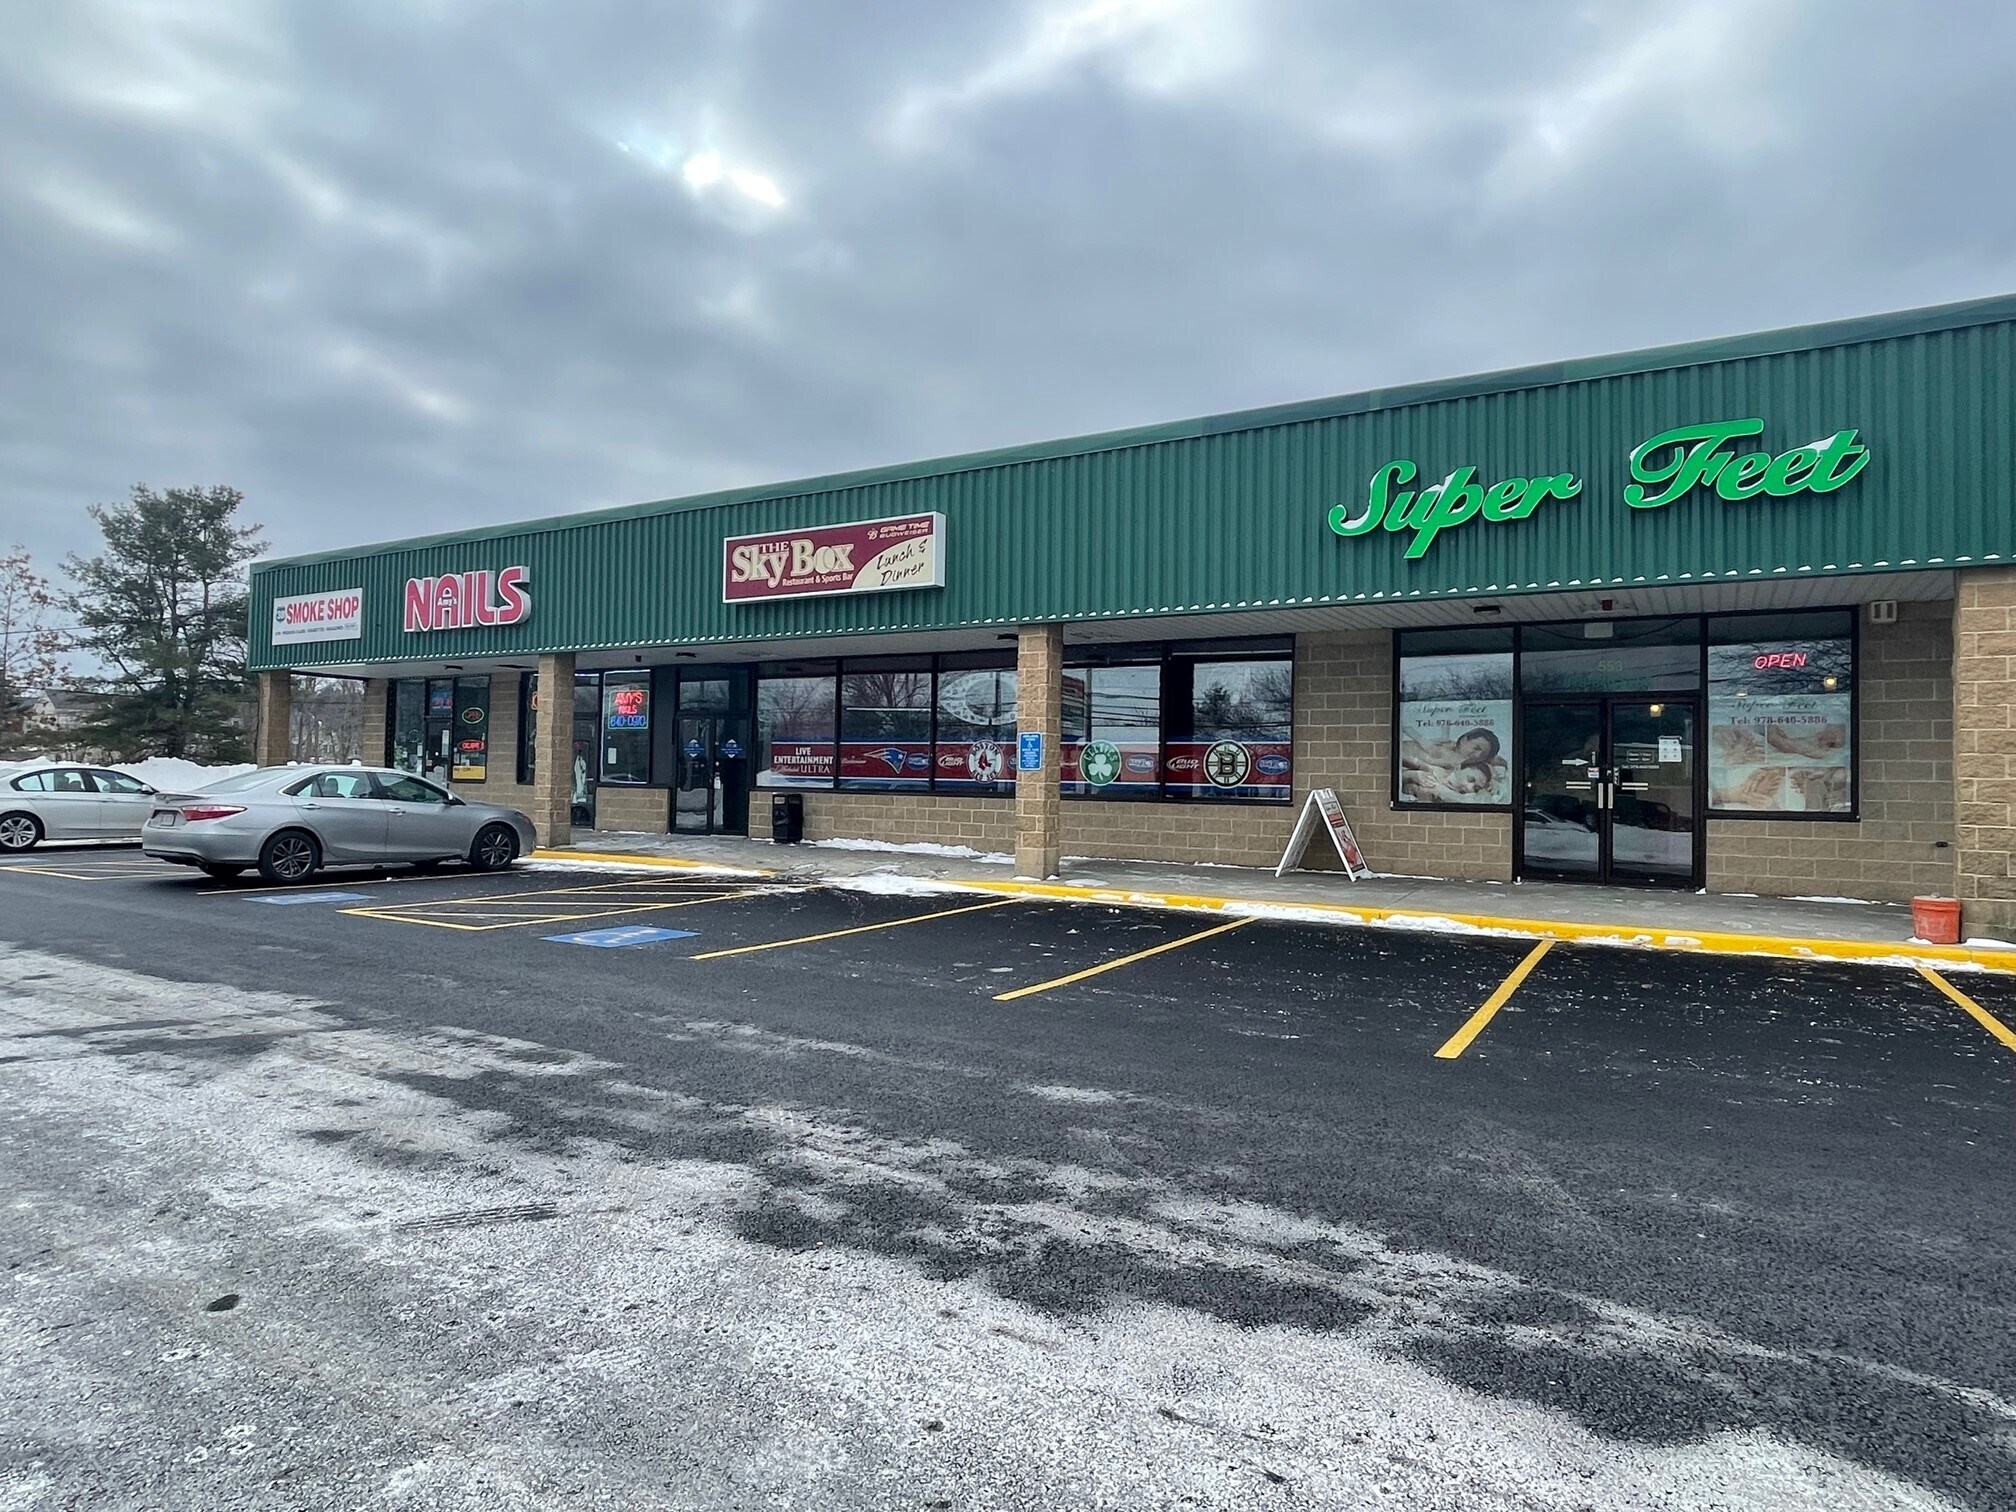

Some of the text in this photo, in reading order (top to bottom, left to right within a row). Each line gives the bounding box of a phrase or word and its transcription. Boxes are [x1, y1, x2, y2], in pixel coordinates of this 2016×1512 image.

[1328, 418, 1871, 559] Super Feet
[759, 541, 789, 553] THE
[876, 543, 915, 570] Lunch
[732, 539, 855, 588] Sky Box
[782, 572, 854, 587] Restaurant & Sports Bar
[880, 562, 925, 586] Dinner
[404, 565, 531, 633] NAILS
[286, 596, 359, 625] SMOKE SHOP
[1754, 653, 1806, 669] OPEN
[773, 755, 834, 765] ENTERTAINMENT
[795, 747, 811, 756] LIVE
[1083, 743, 1118, 762] CELTICS
[800, 765, 831, 774] ULTRA
